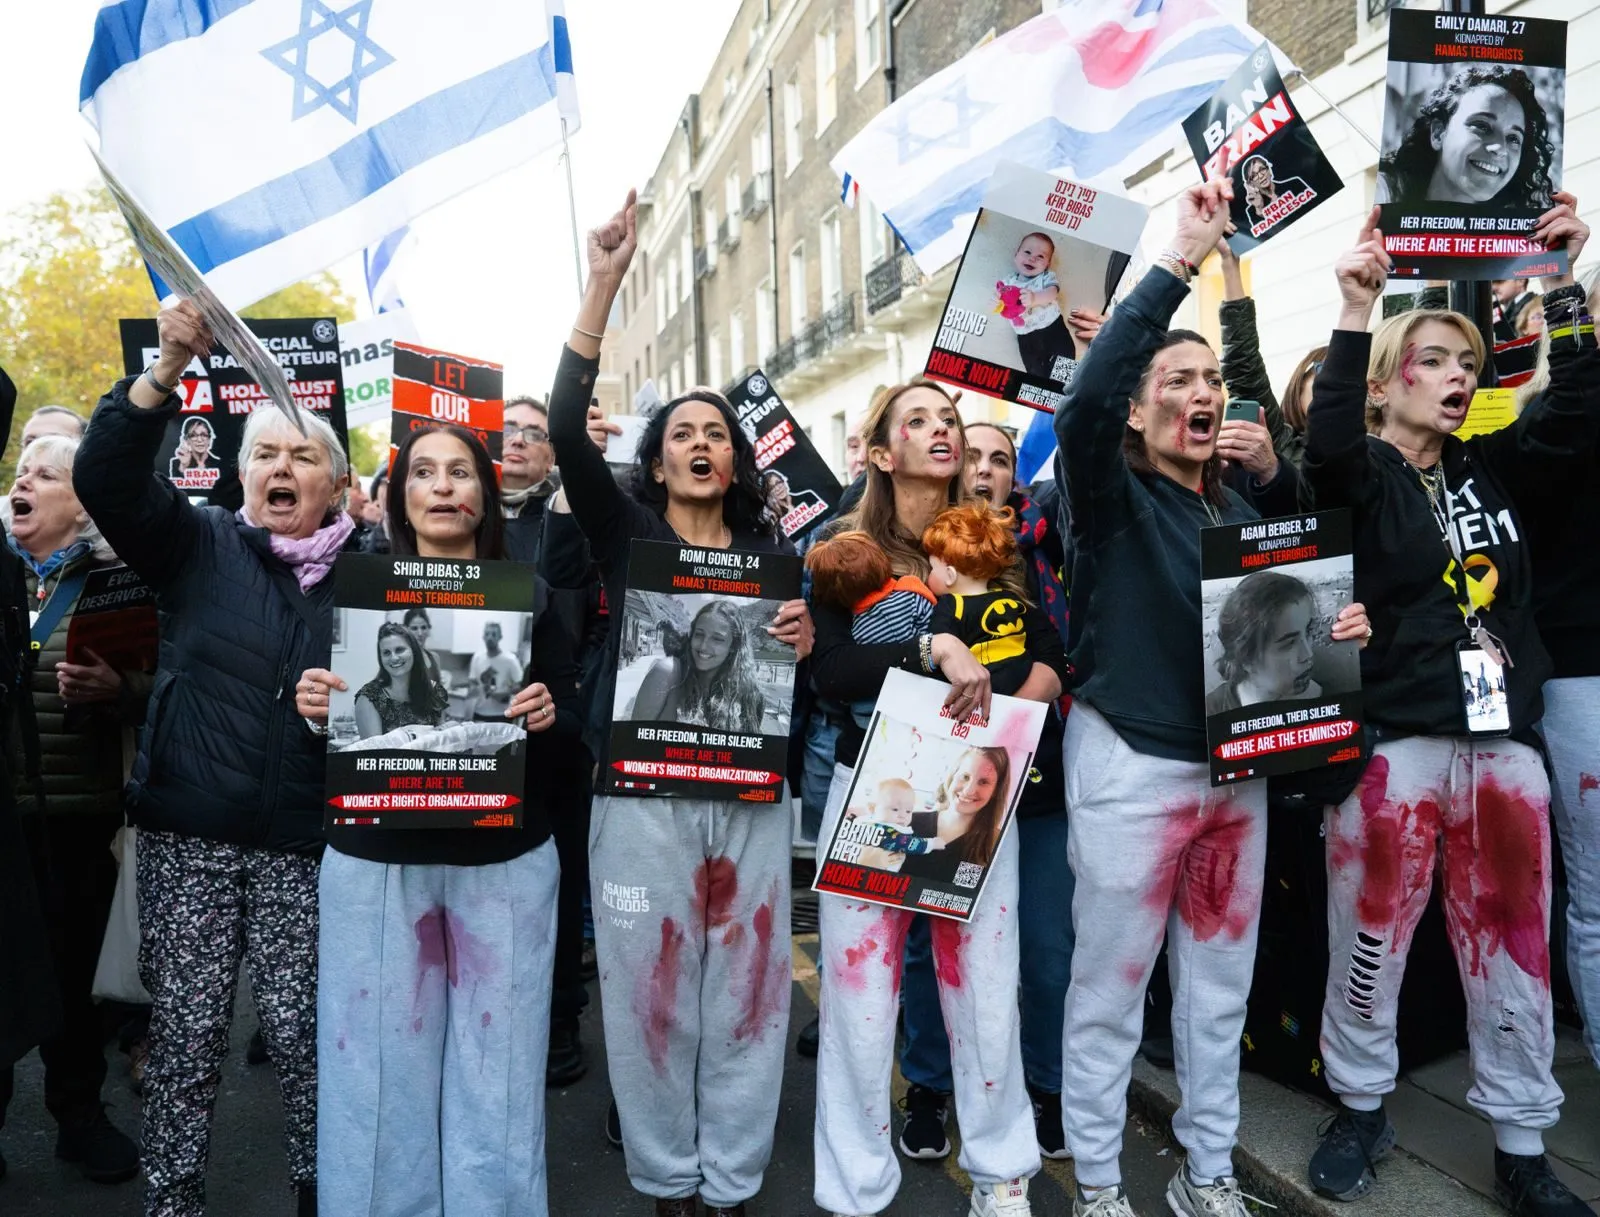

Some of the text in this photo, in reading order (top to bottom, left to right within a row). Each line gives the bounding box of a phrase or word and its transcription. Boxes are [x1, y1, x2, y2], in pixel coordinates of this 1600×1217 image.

[1435, 16, 1526, 35] EMILY DAMARI, 27
[1455, 34, 1504, 46] KIDNAPPED BY
[1435, 44, 1524, 61] HAMAS TERRORISTS
[1203, 76, 1268, 154] BAN
[1046, 193, 1093, 218] KFIR BIBAS
[1252, 190, 1314, 236] FRANCESCA
[1264, 193, 1294, 218] #BAN
[1401, 217, 1420, 228] HER
[1421, 217, 1466, 230] FREEDOM,
[1469, 218, 1496, 230] THEIR
[1386, 237, 1425, 251] WHERE
[1428, 238, 1450, 252] ARE
[1454, 238, 1475, 252] THE
[944, 306, 987, 336] BRING
[936, 327, 966, 352] HIM
[210, 351, 338, 368] RARTEUR
[434, 360, 468, 390] LET
[928, 351, 1010, 391] HOME NOW!
[220, 380, 335, 399] HOLAUST
[431, 392, 470, 423] OUR
[186, 470, 218, 478] #BAN
[782, 504, 808, 526] #BAN
[1241, 518, 1316, 541] AGAM BERGER, 20
[1258, 536, 1300, 551] KIDNAPPED BY
[680, 549, 760, 569] ROMI GONEN, 24
[1242, 545, 1317, 568] HAMAS TERRORISTS
[394, 562, 480, 580] SHIRI BIBAS, 33
[694, 566, 743, 579] KIDNAPPED BY
[409, 579, 464, 591] KIDNAPPED BY
[673, 576, 760, 595] HAMAS TERRORISTS
[386, 590, 485, 606] HAMAS TERRORISTS
[1232, 704, 1340, 734] HER FREEDOM, THEIR SILENCE
[638, 728, 763, 749] HER FREEDOM, THEIR SILENCE
[951, 722, 970, 739] (32)
[1221, 721, 1353, 759] WHERE ARE THE FEMINISTS?
[665, 747, 732, 763] WHERE ARE THE
[357, 758, 497, 772] HER FREEDOM, THEIR SILENCE
[624, 761, 770, 783] WOMEN'S RIGHTS ORGANIZATIONS?
[389, 777, 464, 789] WHERE ARE THE
[343, 794, 507, 807] WOMEN'S RIGHTS ORGANIZATIONS?
[839, 820, 884, 846] BRING
[830, 840, 861, 864] HER
[603, 880, 648, 899] AGAINST
[822, 863, 911, 897] HOME NOW!
[603, 891, 650, 912] ALL ODDS
[918, 894, 970, 913] FAMILIES FORUM
